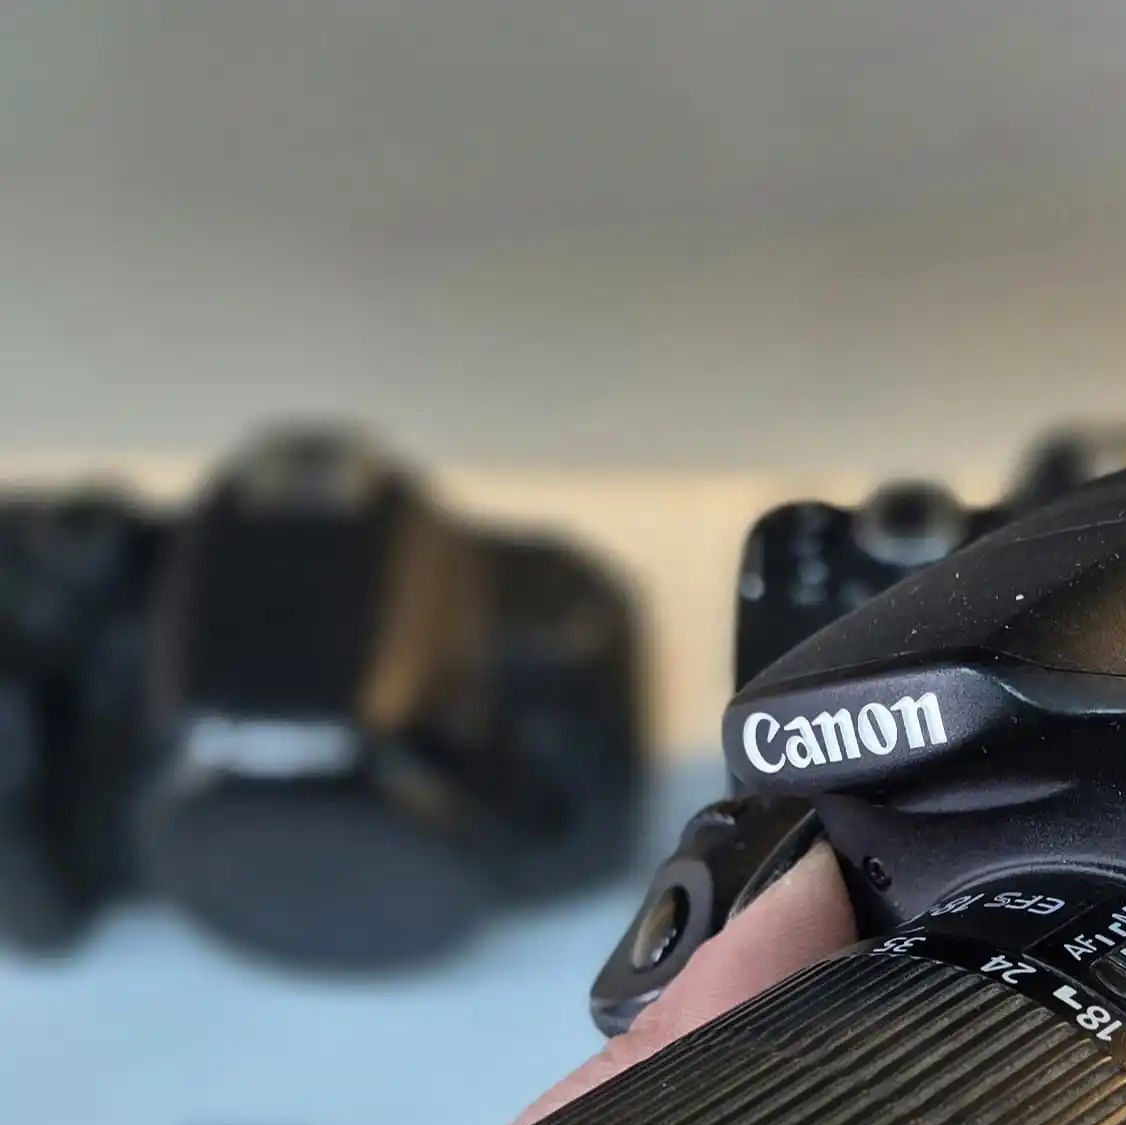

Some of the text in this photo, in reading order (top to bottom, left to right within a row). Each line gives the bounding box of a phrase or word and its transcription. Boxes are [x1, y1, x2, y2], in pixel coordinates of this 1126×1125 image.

[743, 692, 948, 774] Canon
[1063, 933, 1097, 962] AF
[980, 954, 1037, 985] 24
[1076, 1005, 1122, 1042] 18
